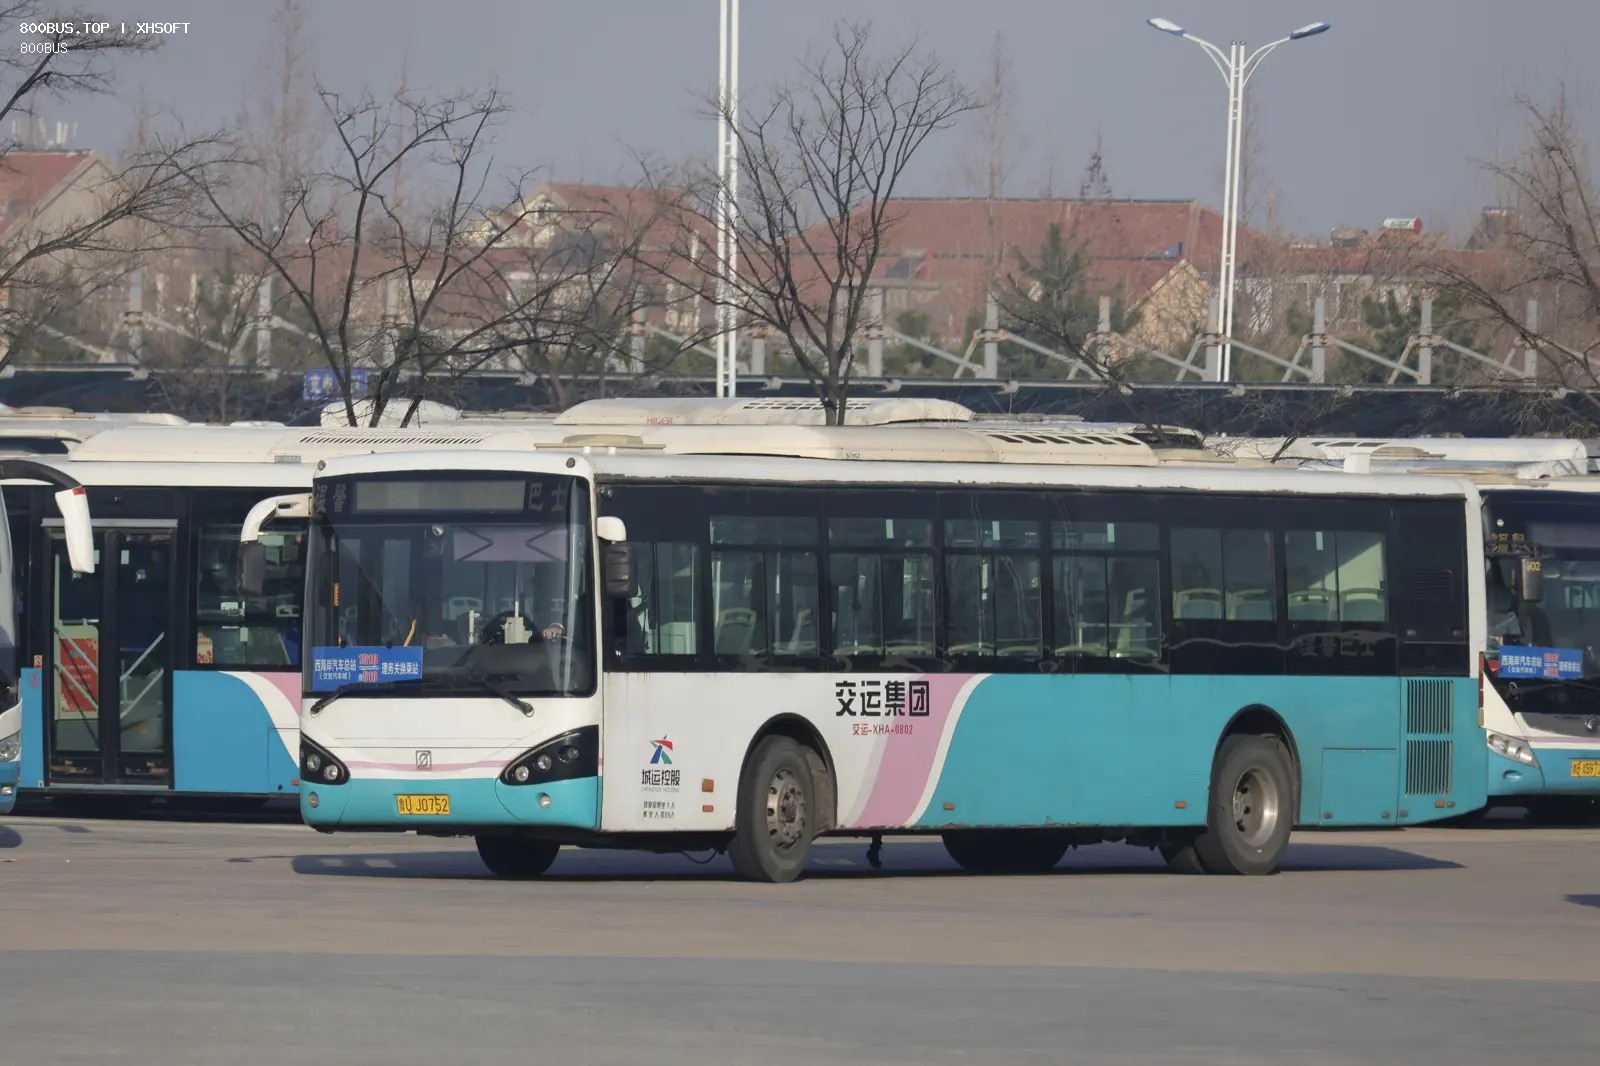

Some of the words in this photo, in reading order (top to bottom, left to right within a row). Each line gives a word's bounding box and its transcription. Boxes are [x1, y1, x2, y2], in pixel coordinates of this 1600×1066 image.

[646, 416, 674, 425] HIGER
[314, 658, 357, 672] 西海岸汽车总站
[835, 680, 930, 717] 交运集团
[852, 723, 914, 736] 交运-XHA-0802
[641, 769, 680, 786] 城运控股
